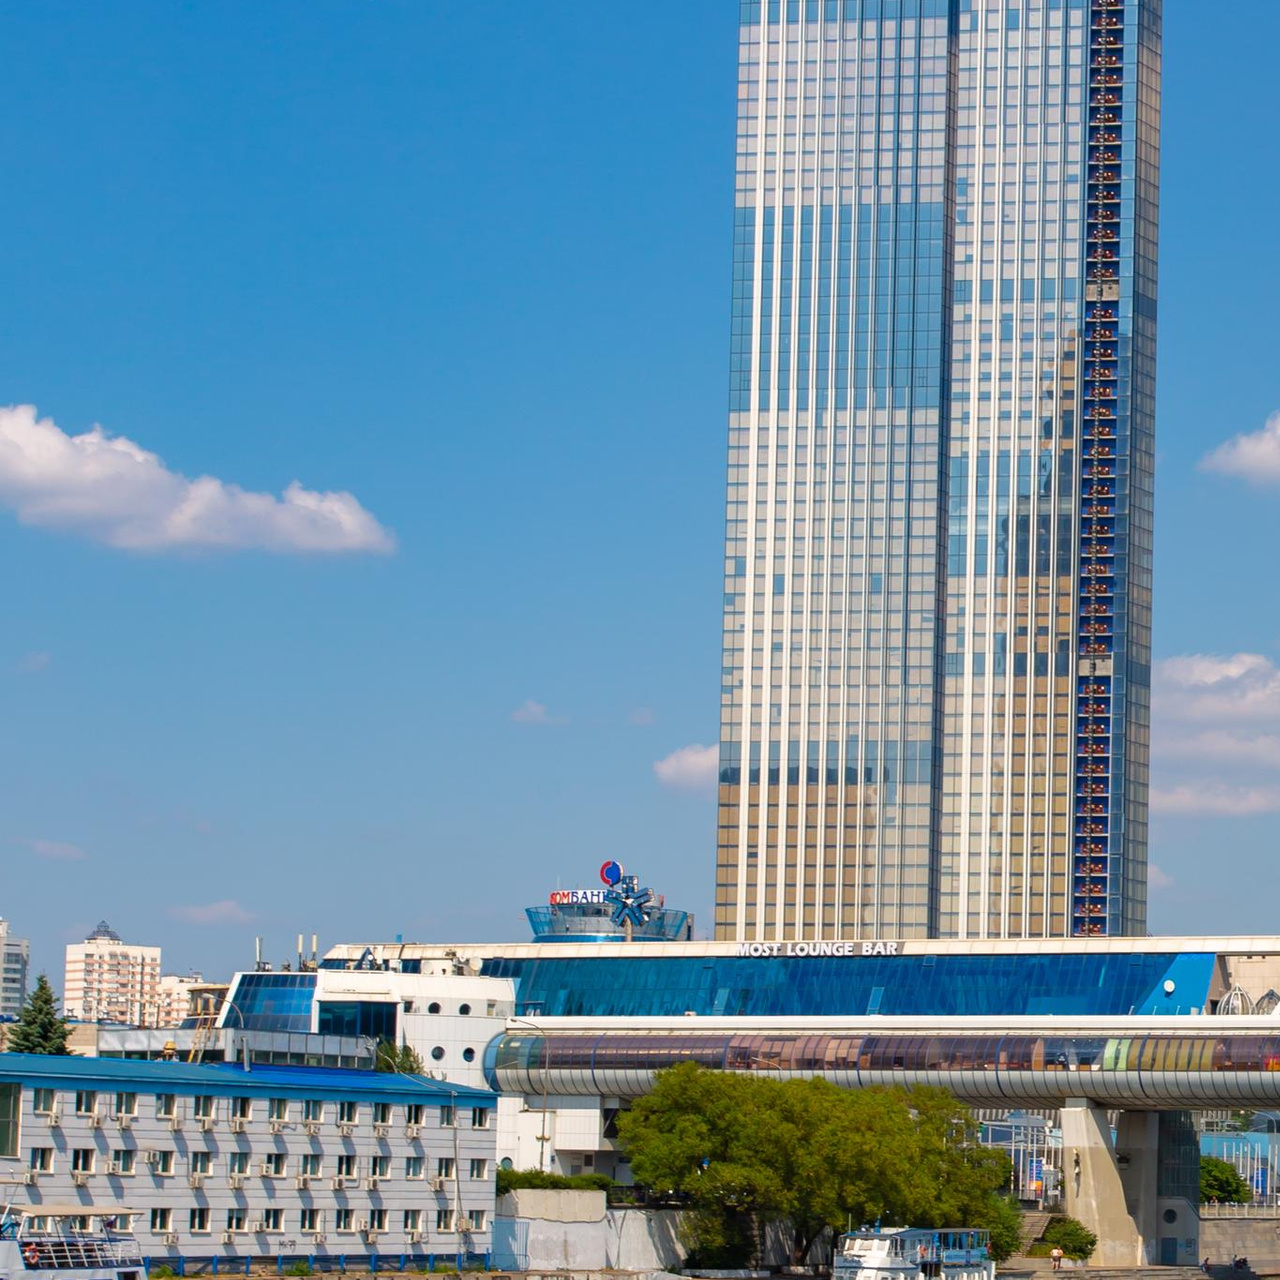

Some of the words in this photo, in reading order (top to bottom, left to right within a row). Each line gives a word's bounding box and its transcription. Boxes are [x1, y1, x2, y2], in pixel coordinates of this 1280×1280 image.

[735, 942, 781, 957] MOST
[786, 942, 855, 957] LOUNGE
[861, 942, 898, 956] BAR
